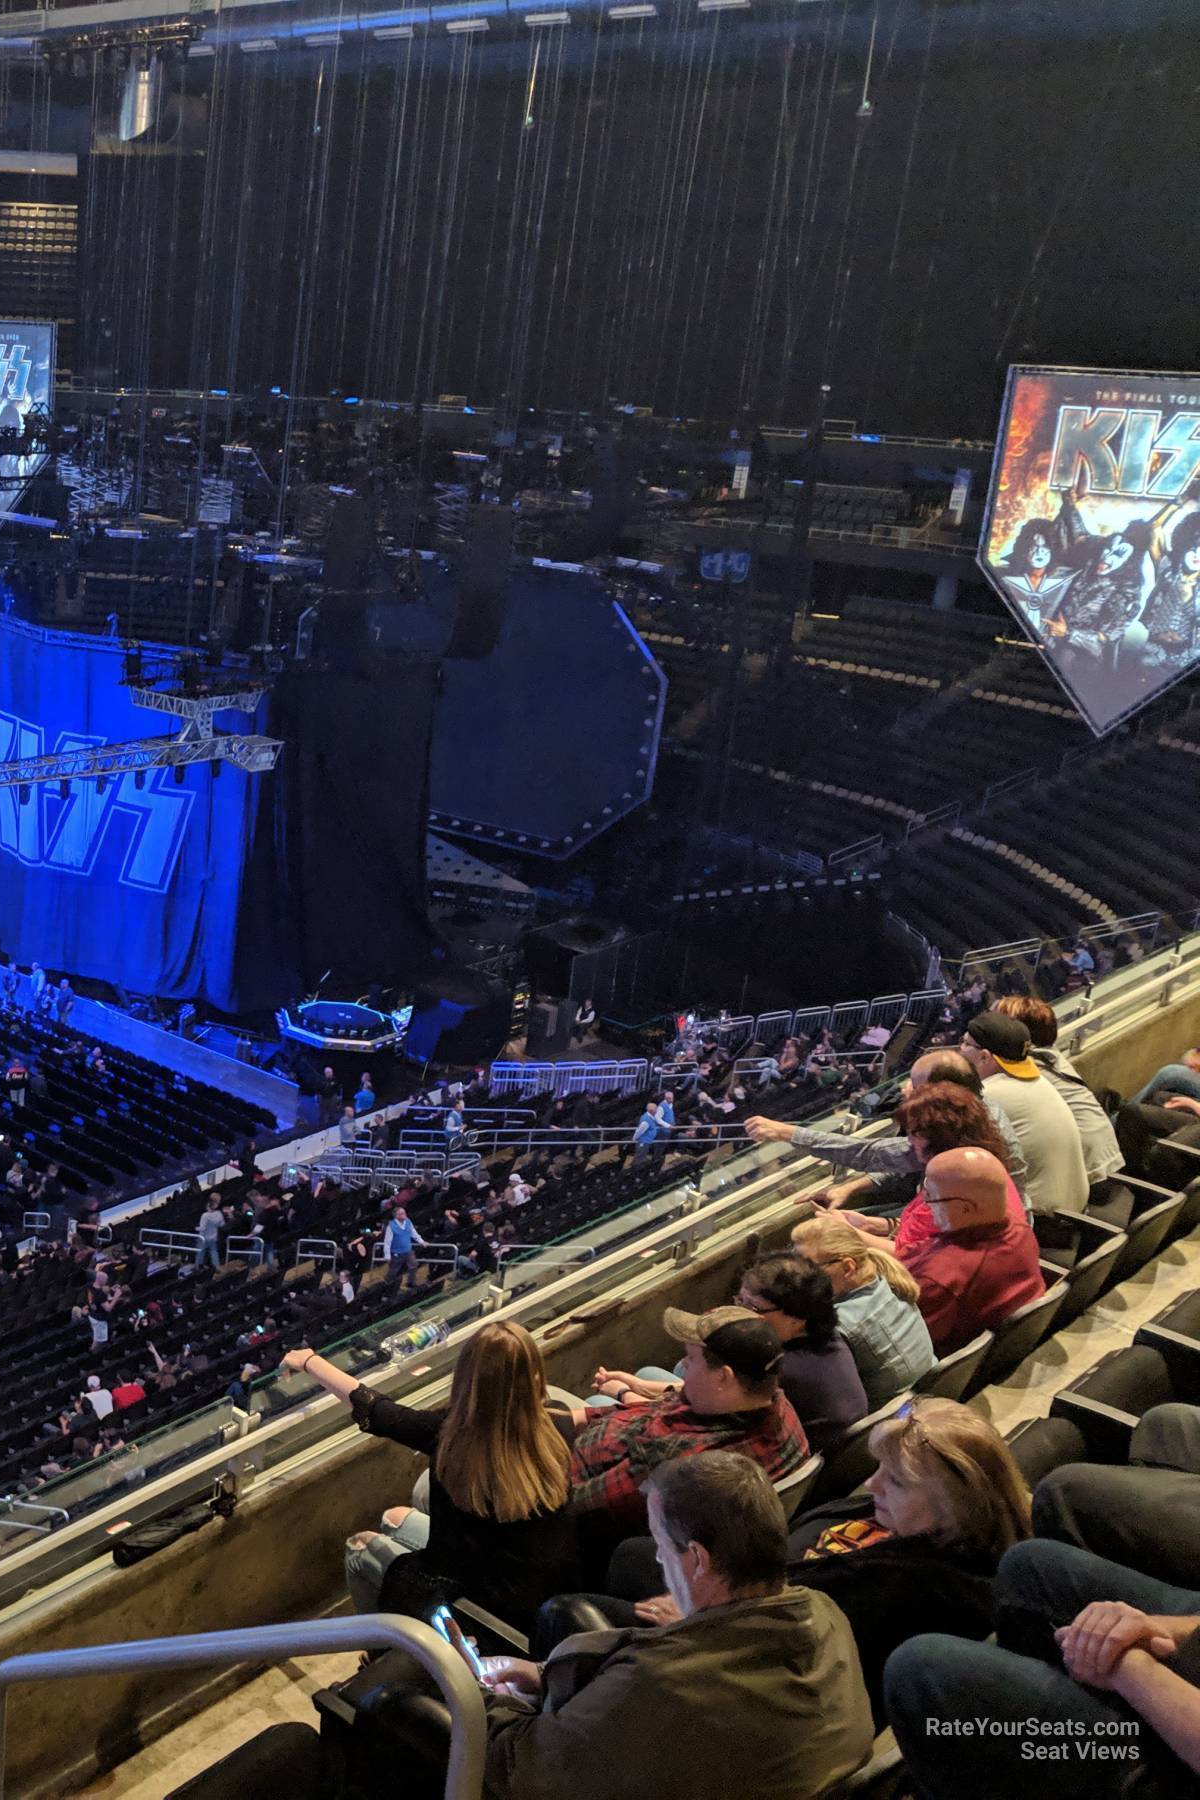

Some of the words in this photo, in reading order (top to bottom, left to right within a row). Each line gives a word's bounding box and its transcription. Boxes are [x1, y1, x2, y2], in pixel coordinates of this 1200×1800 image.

[1095, 390, 1120, 401] THE
[1124, 392, 1163, 404] FINAL
[1168, 395, 1200, 405] TOU
[1048, 405, 1200, 500] KIS
